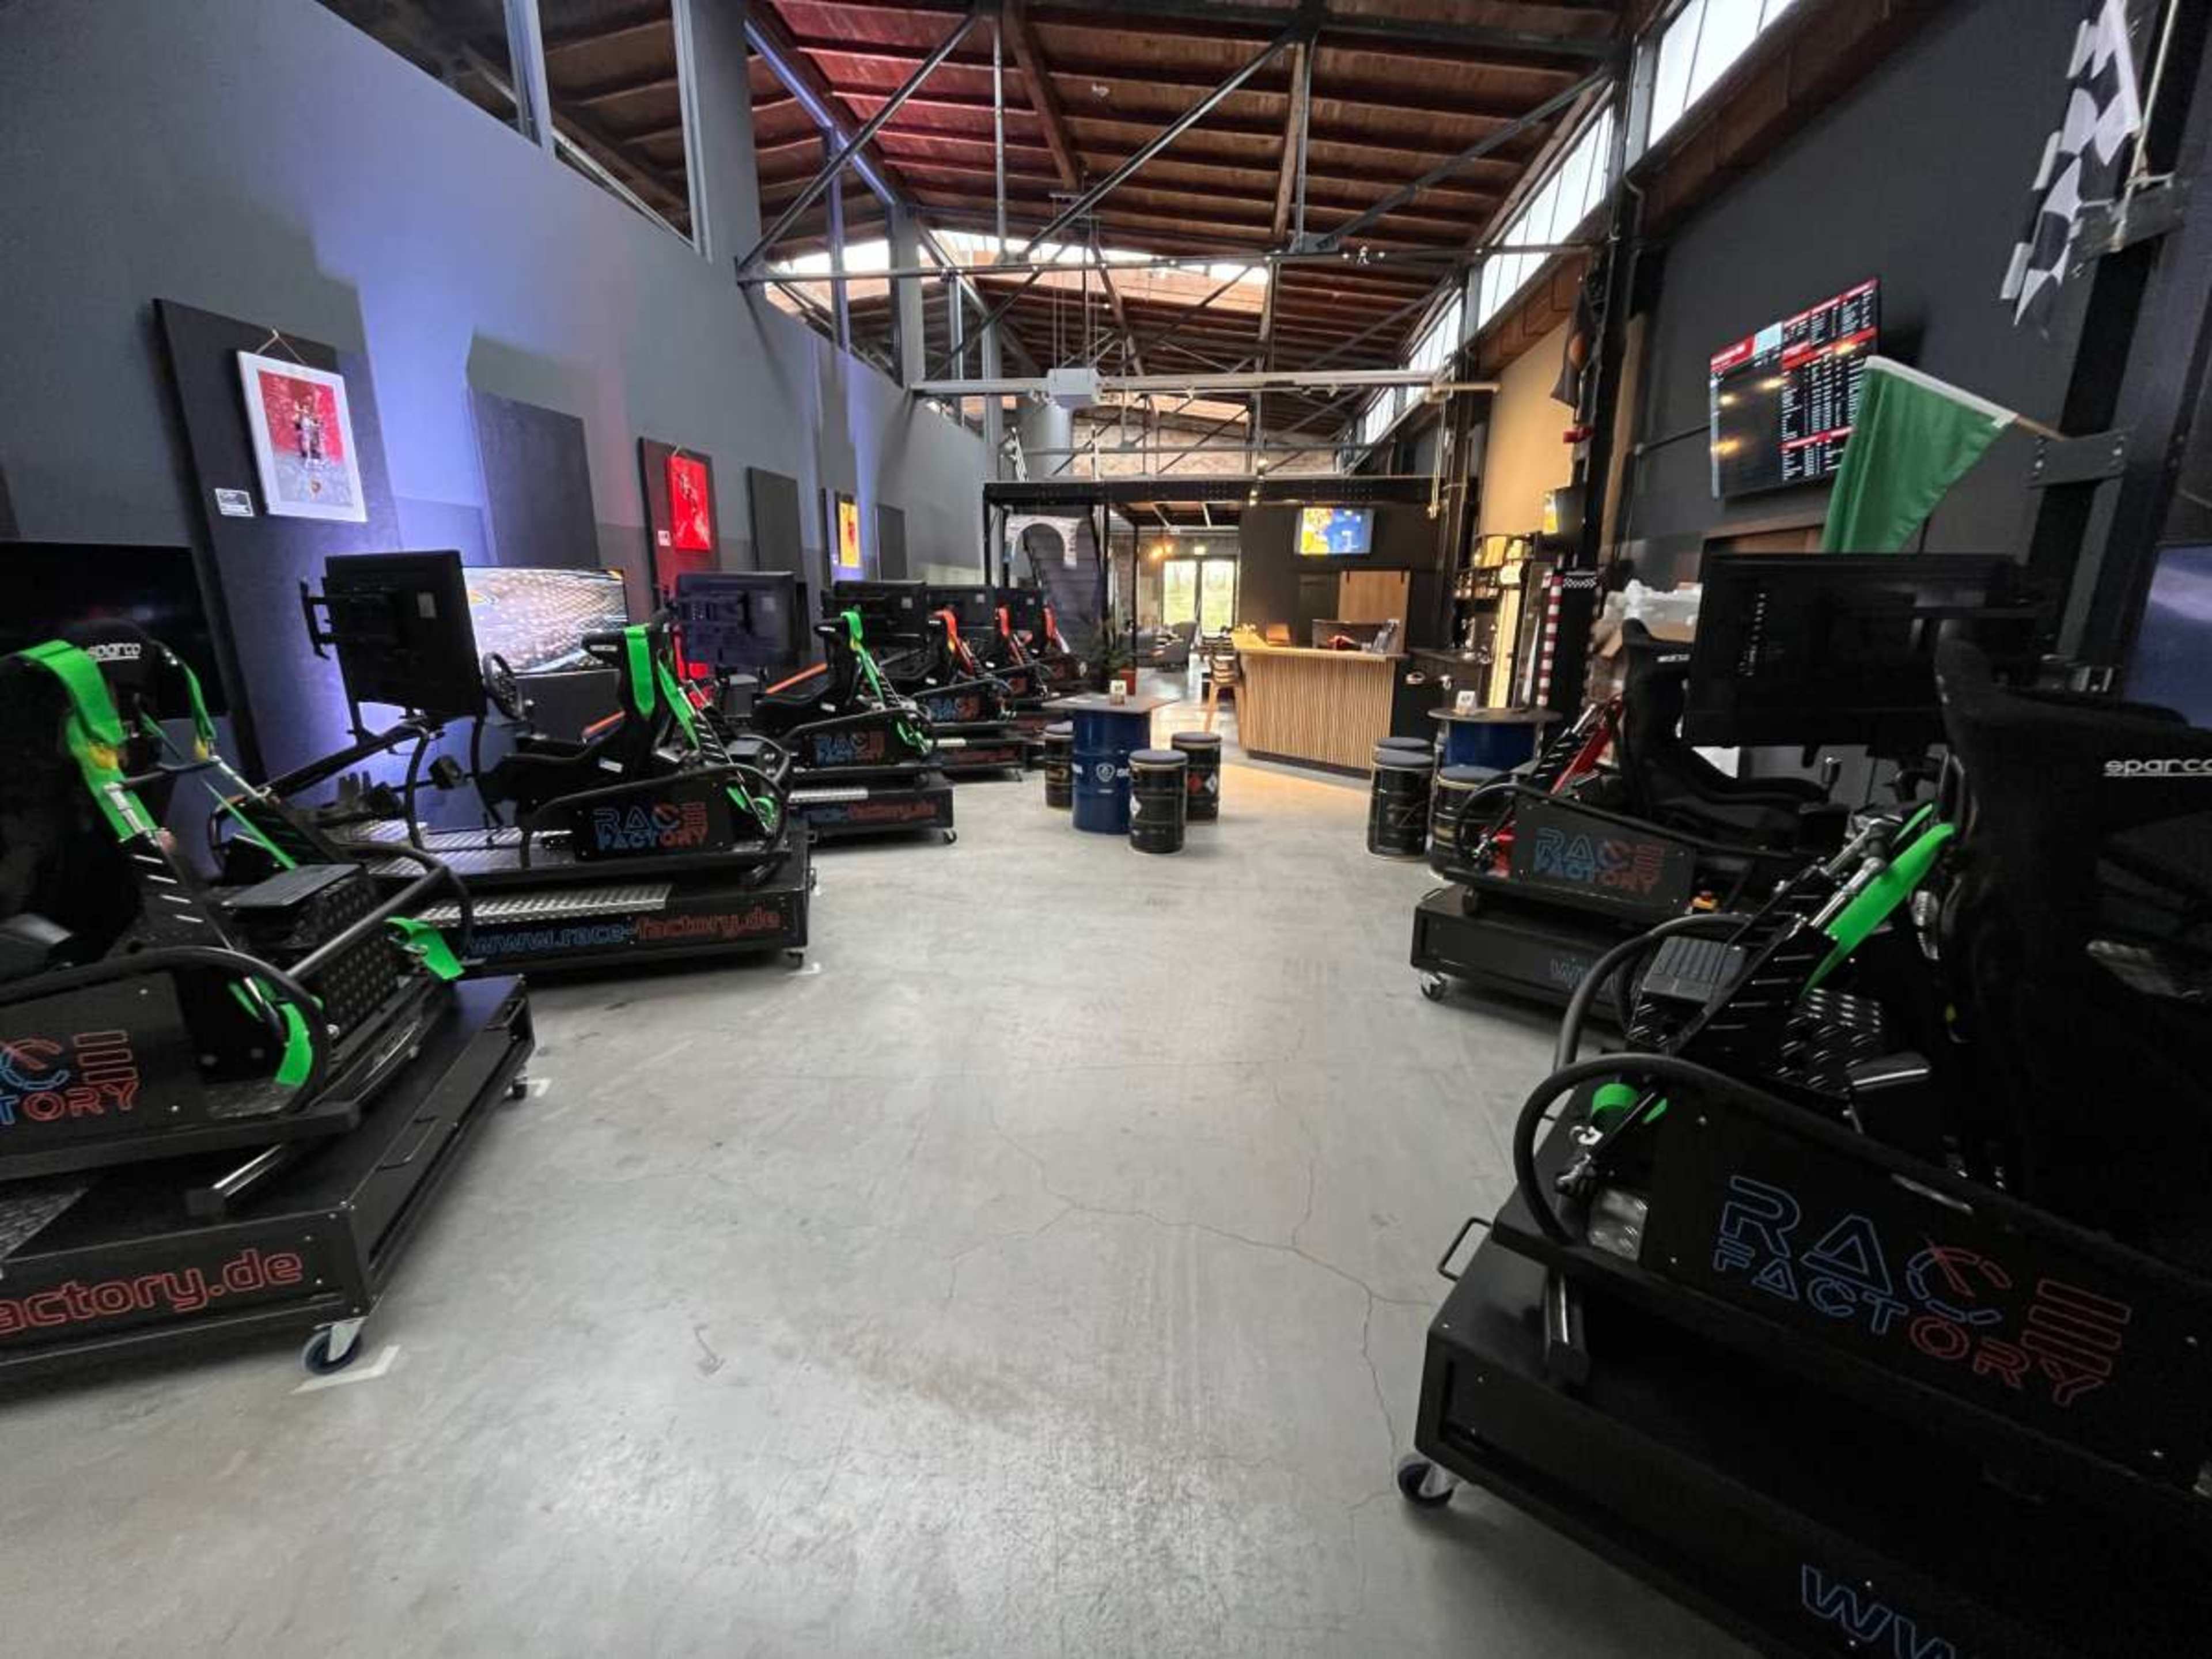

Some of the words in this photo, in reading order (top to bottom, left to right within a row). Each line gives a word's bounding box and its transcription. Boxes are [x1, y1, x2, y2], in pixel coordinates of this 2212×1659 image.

[592, 801, 707, 834] RACE
[1535, 827, 1665, 872] RACE
[1712, 1236, 2108, 1408] FACTORY
[1719, 1175, 2133, 1378] RACE
